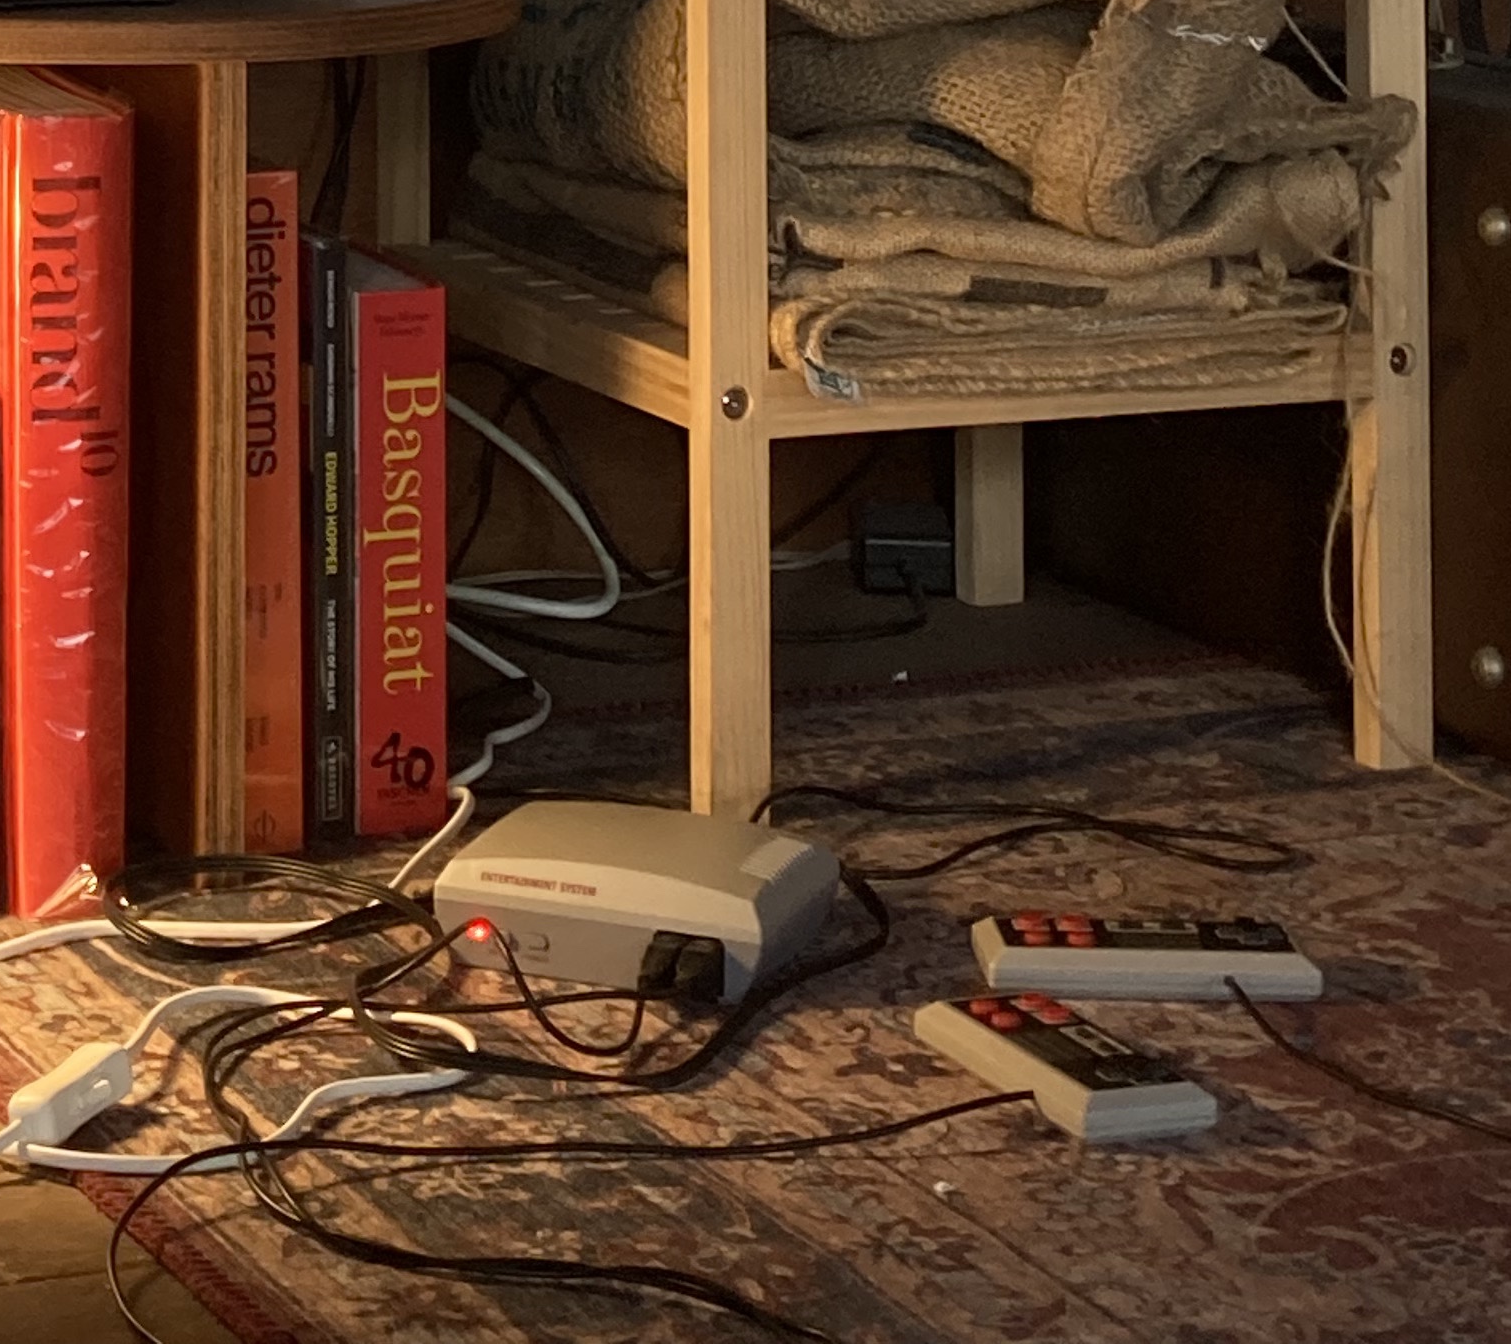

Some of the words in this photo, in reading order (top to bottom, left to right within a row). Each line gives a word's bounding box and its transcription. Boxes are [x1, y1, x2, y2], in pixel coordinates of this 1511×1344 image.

[30, 175, 102, 423] brand
[246, 197, 287, 339] dieter
[246, 352, 279, 478] rams
[325, 451, 338, 512] EDWARD
[325, 515, 338, 576] HOPPER
[363, 369, 443, 696] Basquiat
[370, 731, 435, 790] 40
[480, 871, 557, 892] ENTERTAINMENT
[560, 881, 598, 897] SYSTEM
